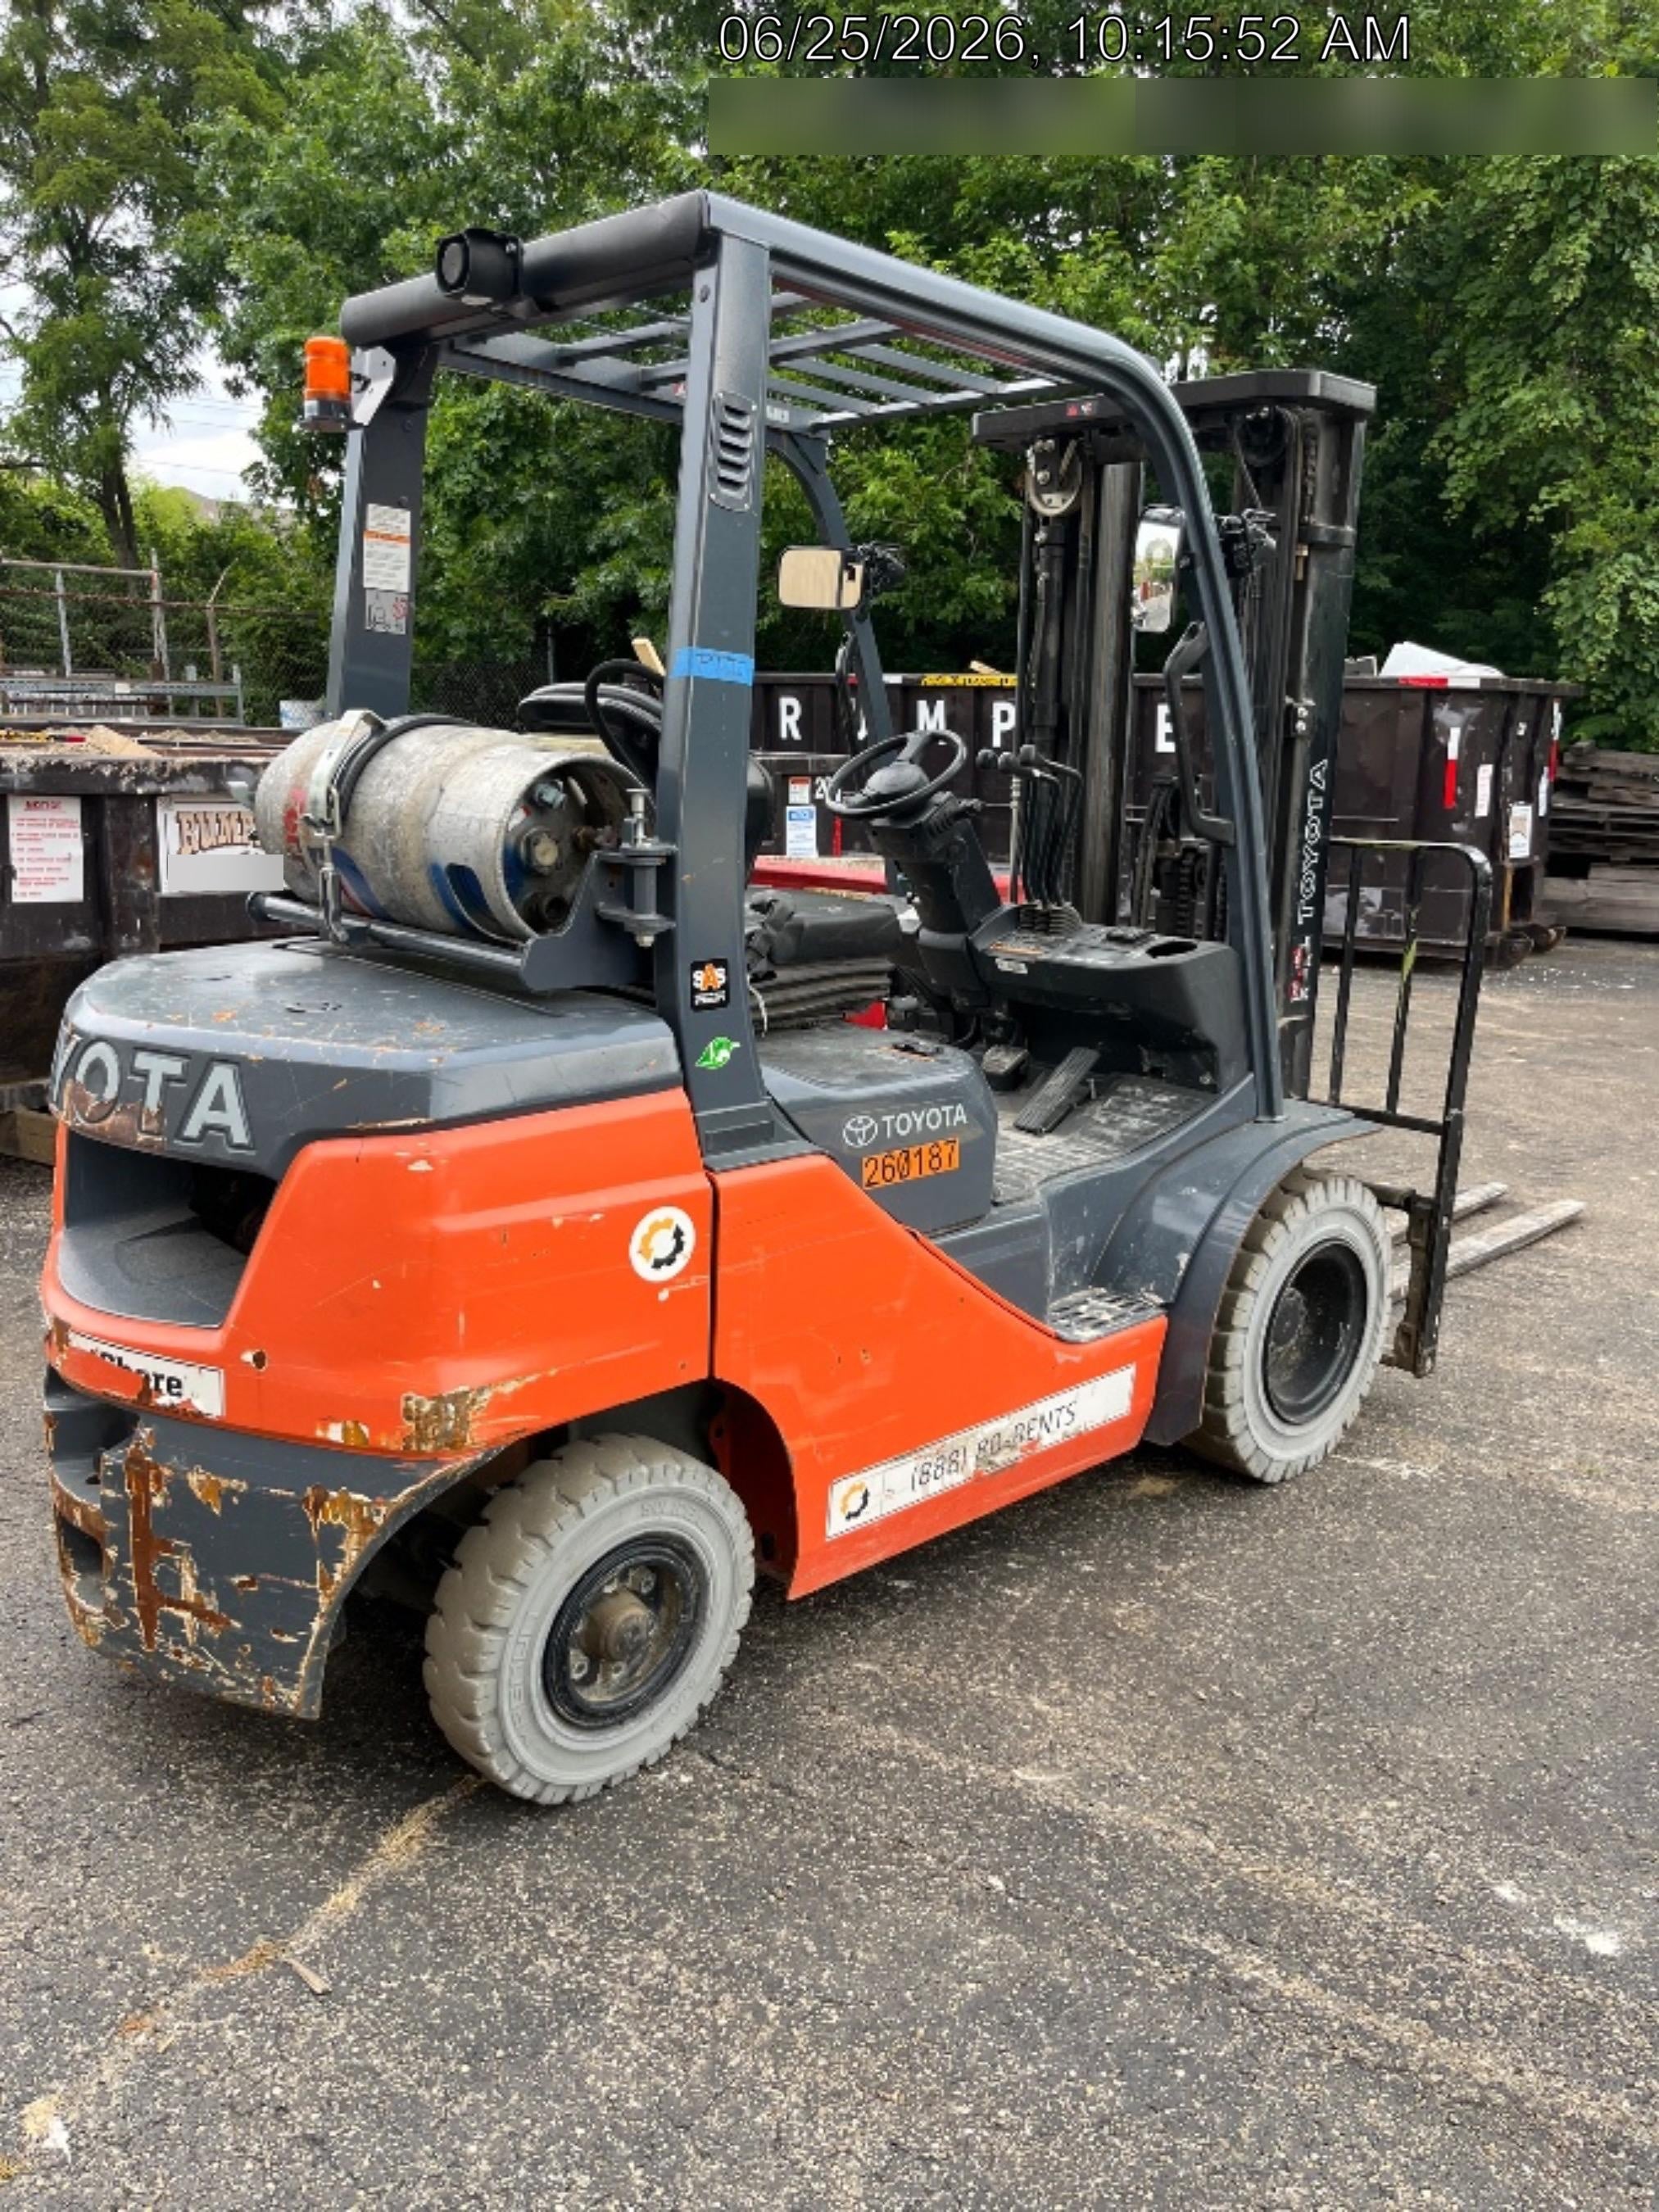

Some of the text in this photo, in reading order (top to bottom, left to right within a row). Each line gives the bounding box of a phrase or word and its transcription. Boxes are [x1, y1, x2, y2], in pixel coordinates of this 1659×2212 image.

[1297, 758, 1329, 926] TOYOTA
[881, 1103, 968, 1140] TOYOTA
[863, 1139, 958, 1188] 260187
